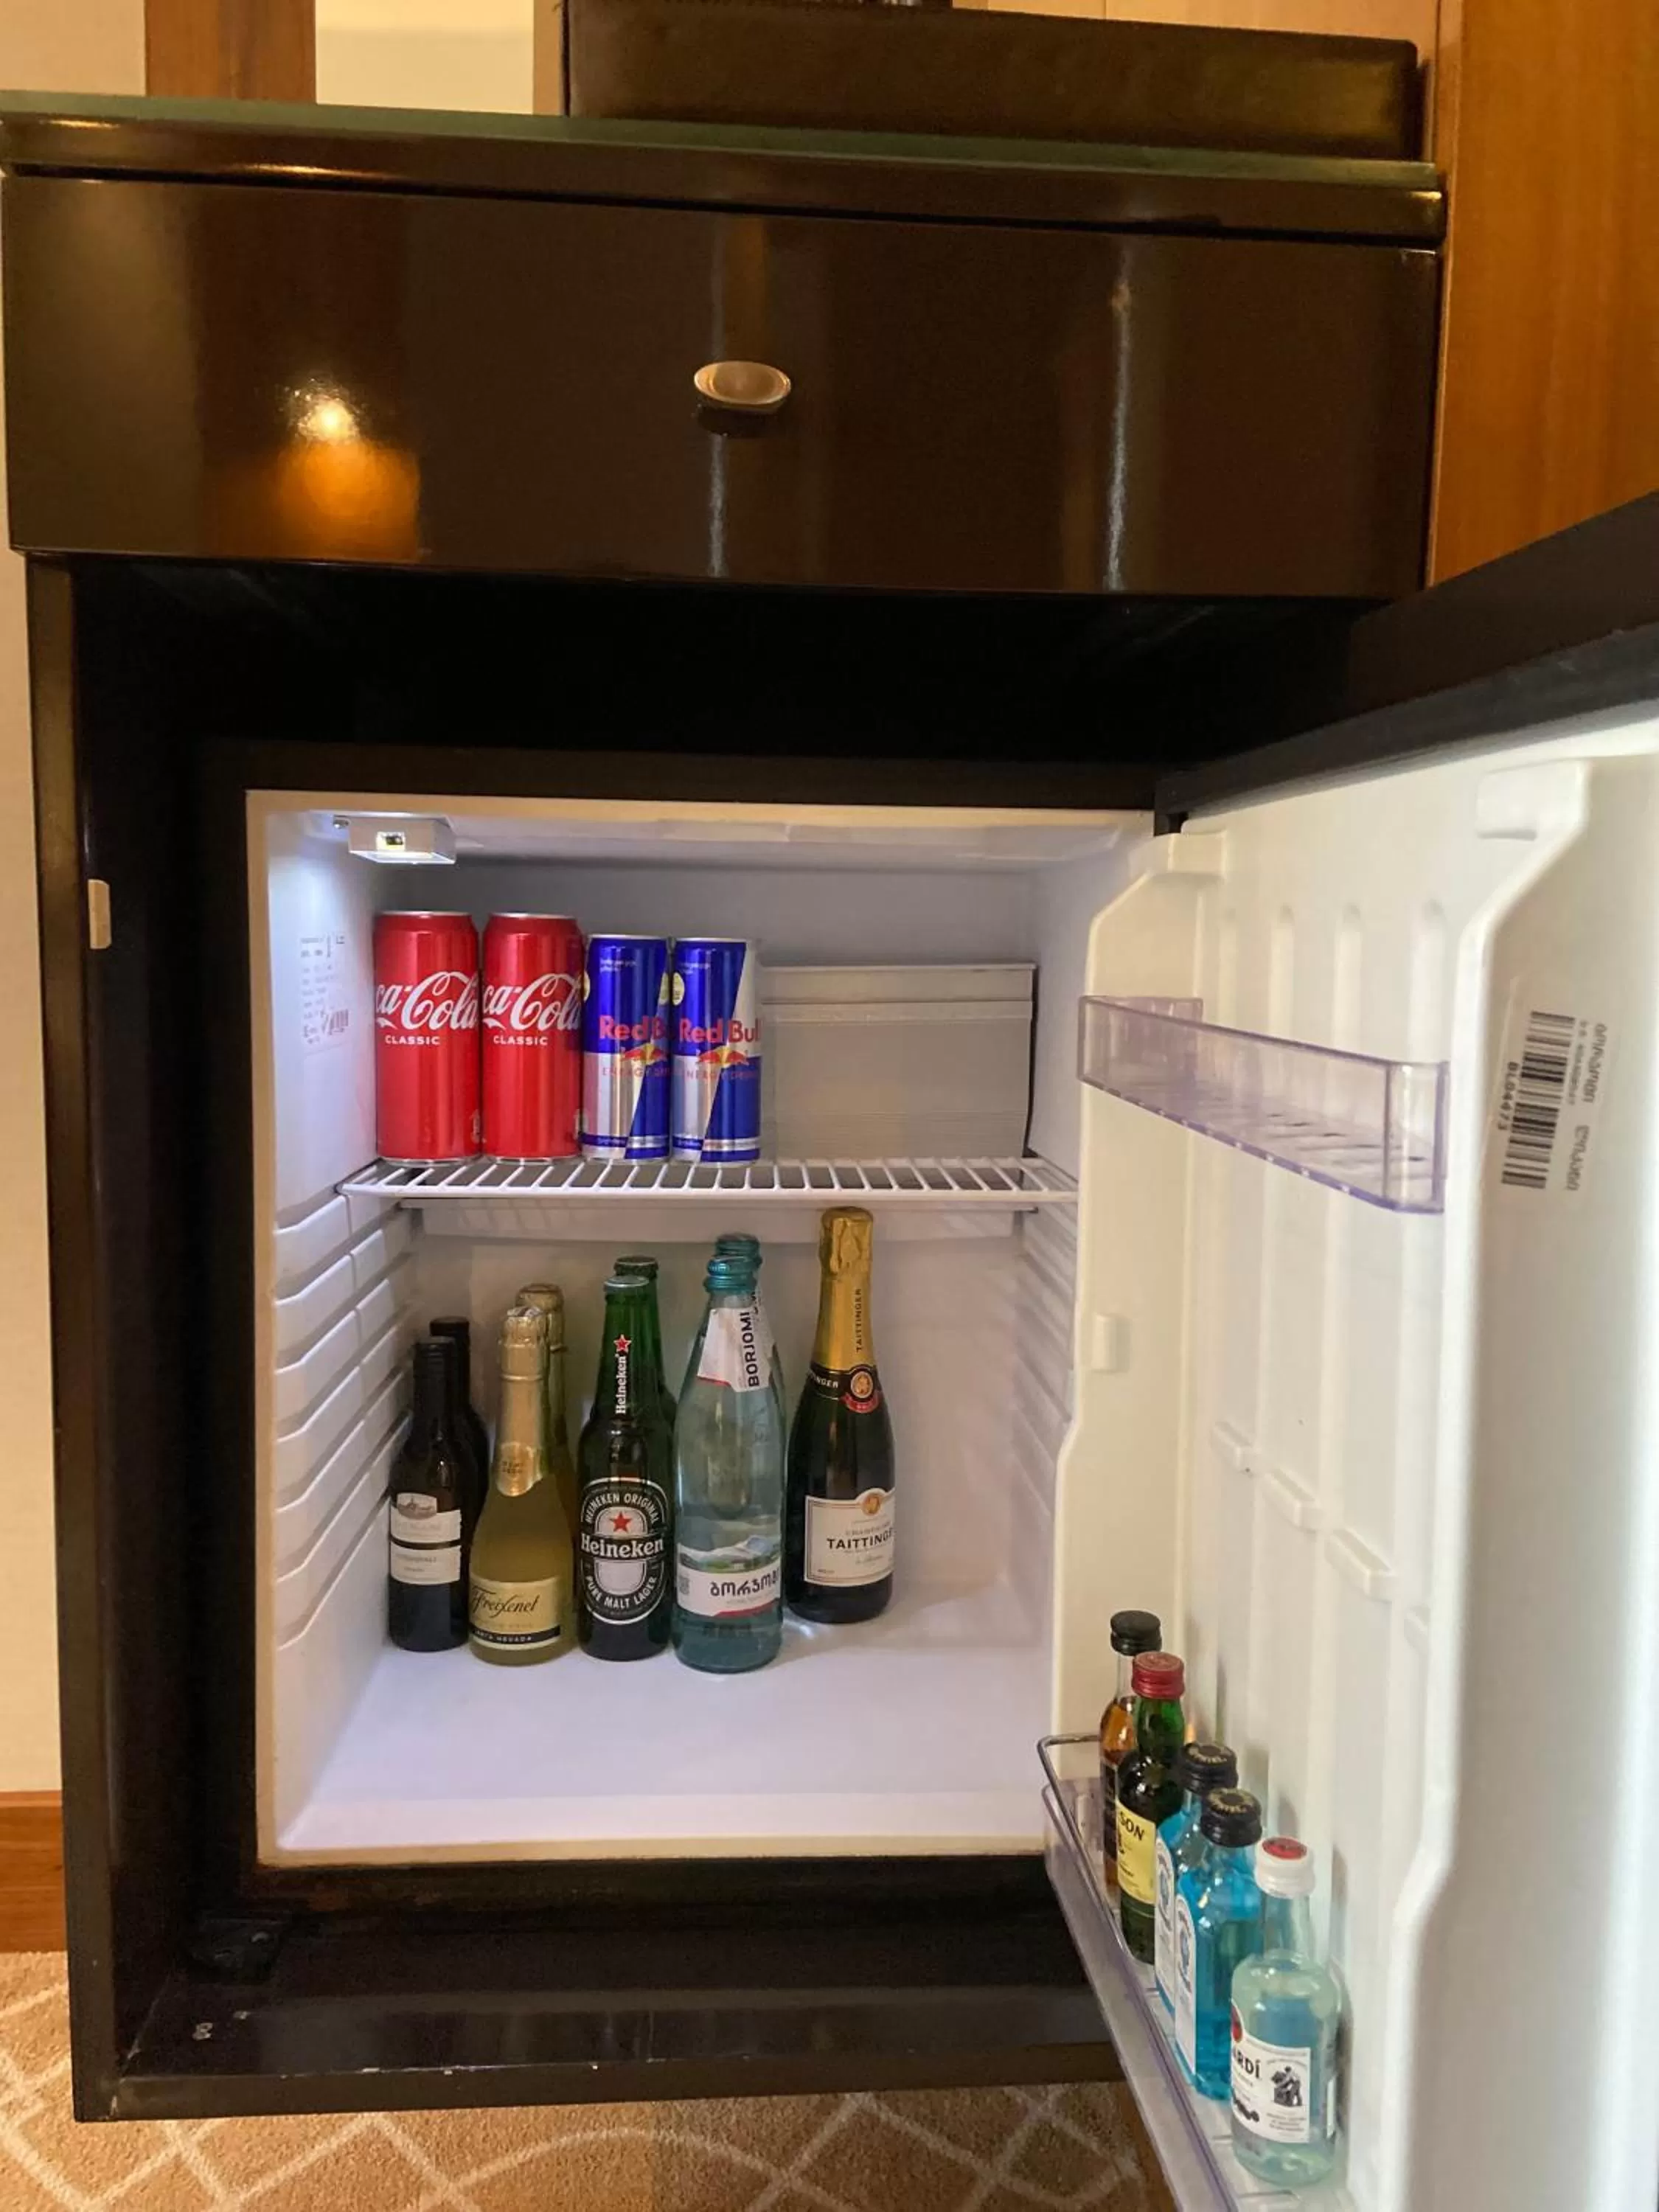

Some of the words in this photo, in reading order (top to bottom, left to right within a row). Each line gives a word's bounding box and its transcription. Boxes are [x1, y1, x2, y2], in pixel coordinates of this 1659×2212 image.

[385, 1034, 440, 1046] CLASSIC
[493, 1035, 549, 1046] CLASSIC
[599, 1015, 649, 1041] Red
[679, 1018, 723, 1043] Red
[727, 1018, 760, 1043] Bul
[740, 1312, 760, 1387] BORJOMI
[615, 1356, 627, 1414] Heineken
[585, 1493, 620, 1524] HEINEKEN
[623, 1493, 660, 1524] ORIGINAL
[581, 1533, 664, 1558] Heineken
[585, 1575, 602, 1602] PURE
[604, 1596, 630, 1609] MALT
[634, 1576, 657, 1605] LAGER
